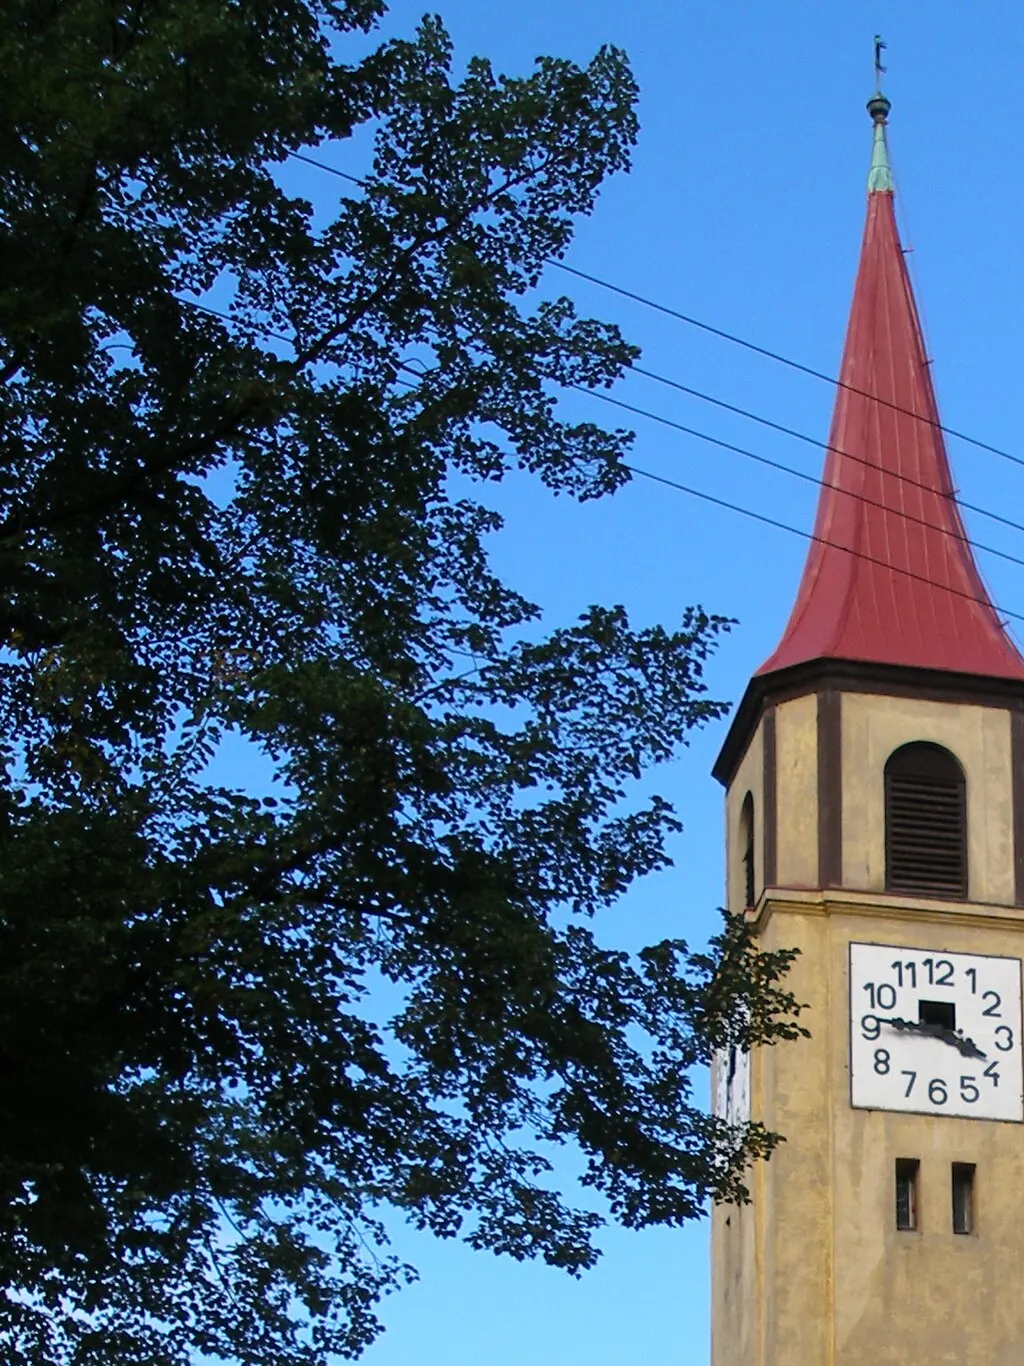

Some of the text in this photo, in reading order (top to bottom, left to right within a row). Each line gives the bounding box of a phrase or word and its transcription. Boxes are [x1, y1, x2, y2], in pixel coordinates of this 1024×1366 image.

[891, 960, 917, 987] 11
[922, 958, 955, 987] 12
[965, 968, 977, 994] 1
[863, 982, 897, 1009] 10
[982, 991, 1002, 1018] 2
[861, 1014, 880, 1041] 9
[994, 1026, 1013, 1051] 3
[873, 1048, 890, 1075] 8
[983, 1061, 1000, 1087] 4
[901, 1070, 917, 1098] 7
[928, 1078, 948, 1105] 6
[960, 1075, 980, 1103] 5
